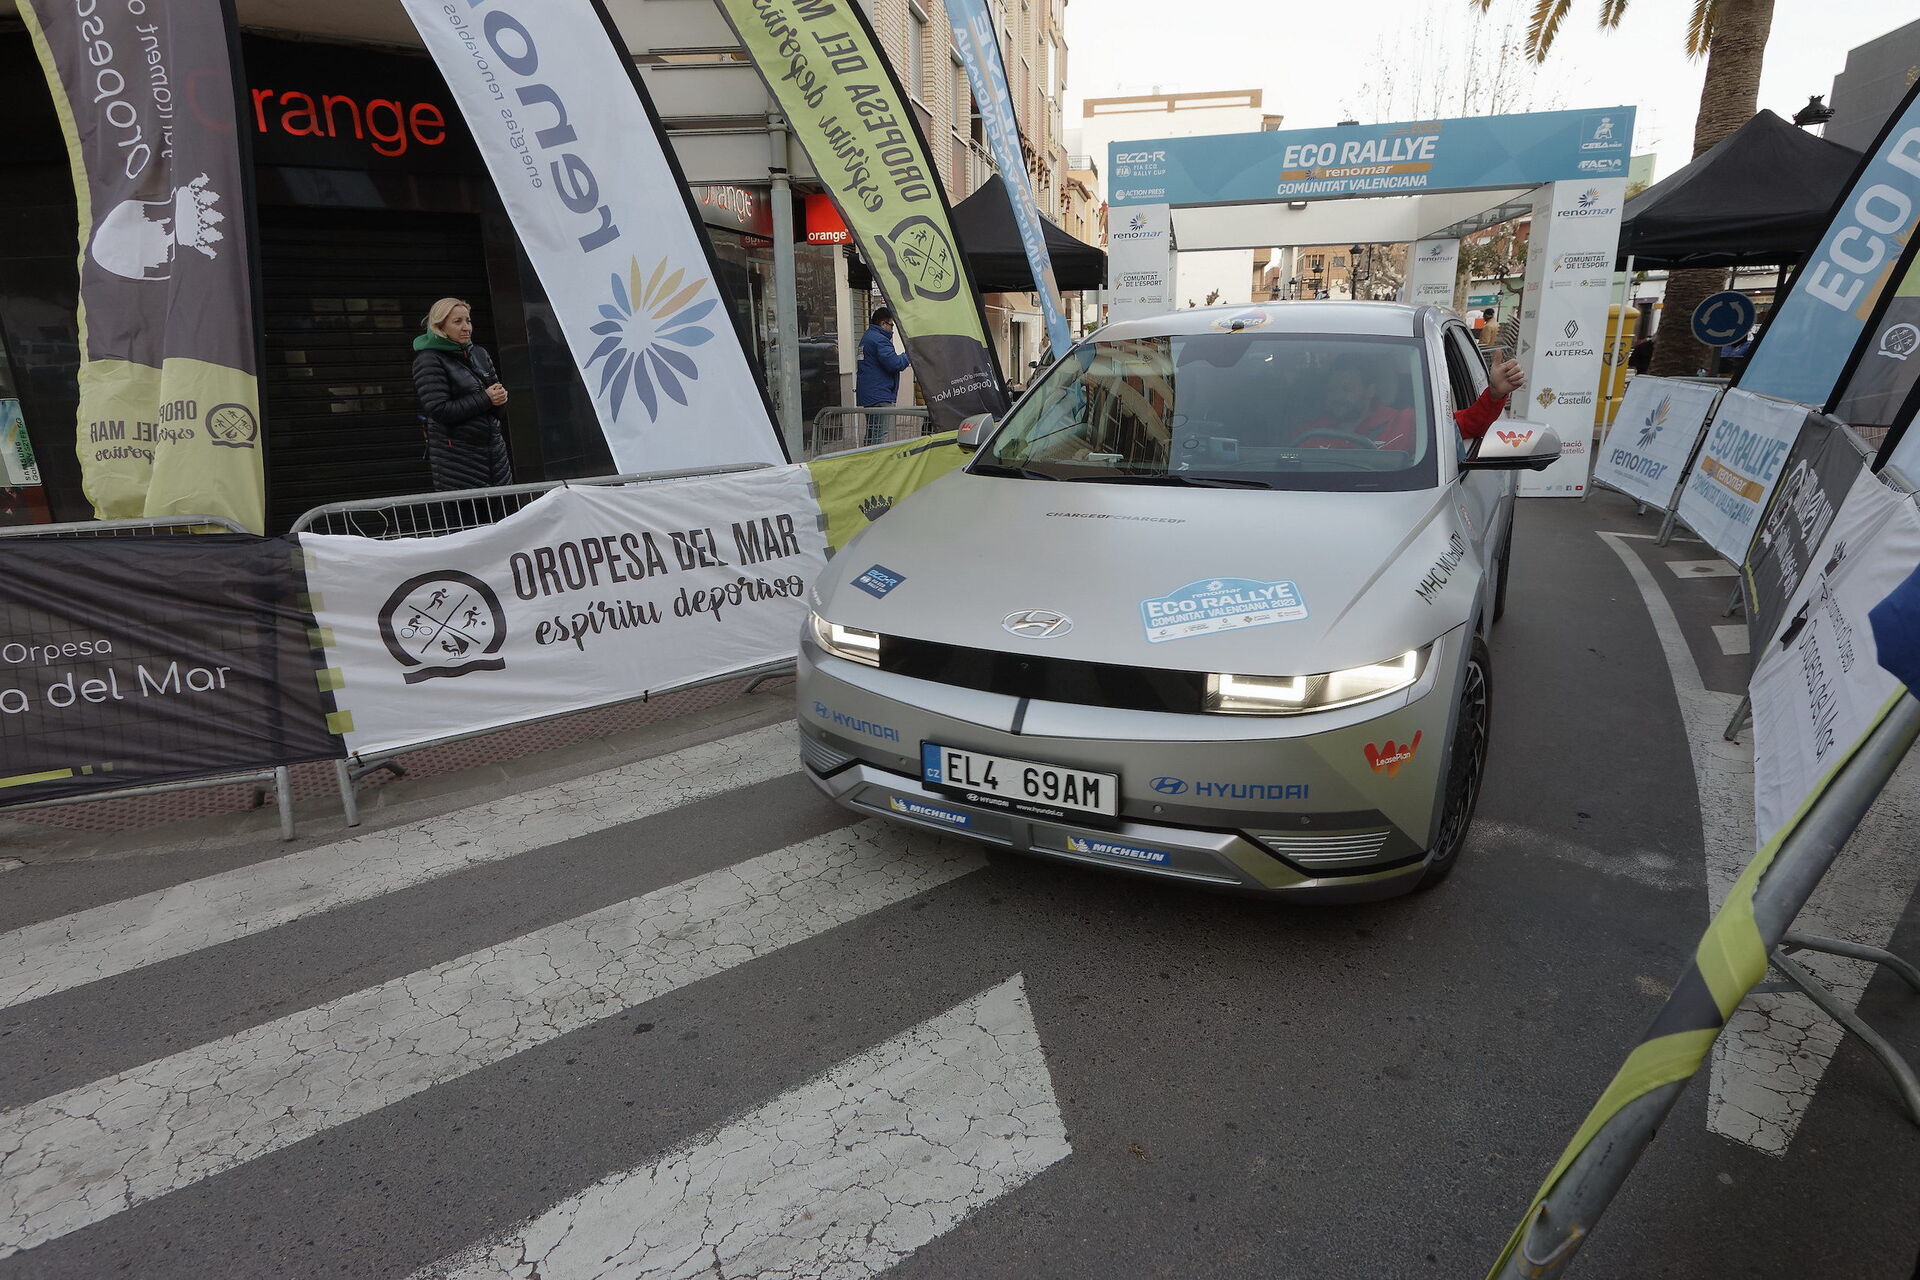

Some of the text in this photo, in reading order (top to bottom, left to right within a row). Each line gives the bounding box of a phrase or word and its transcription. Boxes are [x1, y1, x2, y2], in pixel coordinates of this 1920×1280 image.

[1282, 135, 1440, 169] ECO RALLYE
[1325, 165, 1394, 178] renomar
[1277, 175, 1428, 195] COMUNITAT VALENCIANA
[1557, 207, 1616, 217] renomar
[808, 231, 847, 243] orange
[1113, 231, 1162, 239] renomar
[1805, 183, 1912, 312] ECO
[1564, 255, 1605, 264] COMUNITAT
[1577, 261, 1609, 269] L'ESPORT
[1123, 274, 1158, 282] COMUNITAT
[1545, 348, 1594, 357] AUTERSA
[1555, 340, 1584, 348] GRUPO
[1557, 396, 1591, 405] Castelló
[1610, 448, 1668, 480] renomar
[1716, 467, 1748, 492] renomar
[509, 514, 801, 600] OROPESA DEL MAR
[1192, 588, 1242, 599] renomar
[1415, 568, 1448, 605] MHC
[1147, 583, 1294, 617] ECO RALLYE
[535, 600, 663, 651] espíritu
[674, 575, 804, 622] deportivo
[1151, 612, 1205, 627] COMUNITAT
[1208, 602, 1270, 617] VALENCIANA
[2, 640, 112, 665] Orpesa
[47, 668, 124, 707] del
[138, 661, 231, 697] Mar
[833, 711, 900, 742] HYUNDAI
[1375, 751, 1411, 767] LeasePlan
[927, 752, 1101, 809] CZ EL4 69AM
[1196, 781, 1309, 799] HYUNDAI
[908, 803, 967, 824] MICHELIN
[980, 796, 1064, 817] HYUNDAI www.hyundai.cz
[1091, 842, 1165, 862] MICHELIN
